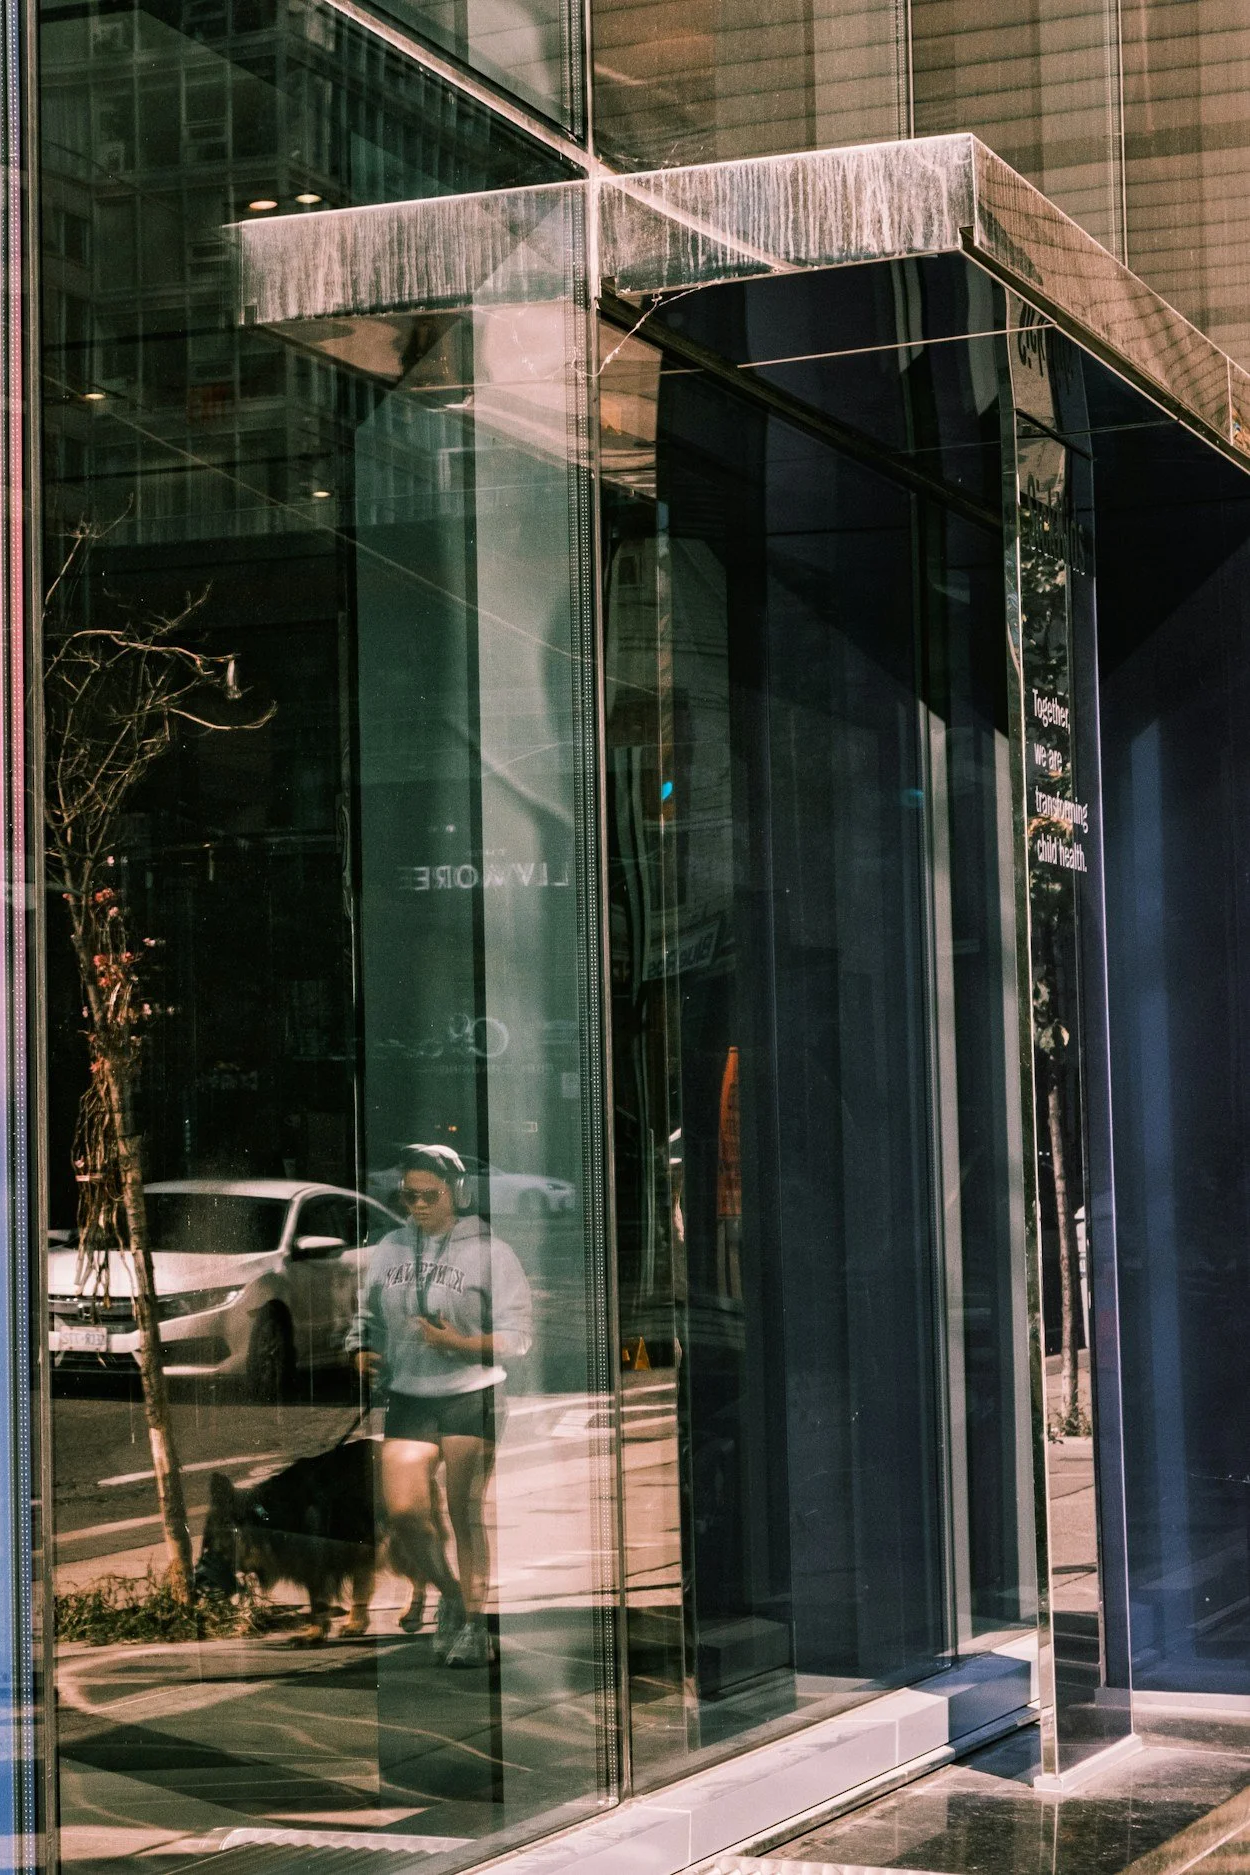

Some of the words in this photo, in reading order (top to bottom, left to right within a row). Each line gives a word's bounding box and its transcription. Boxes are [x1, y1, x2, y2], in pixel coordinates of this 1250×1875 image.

[1032, 688, 1071, 735] Together,
[1034, 743, 1047, 767] we
[1048, 748, 1063, 772] are
[1035, 785, 1089, 834] transforming
[1036, 833, 1058, 865] child
[1058, 838, 1088, 873] health.
